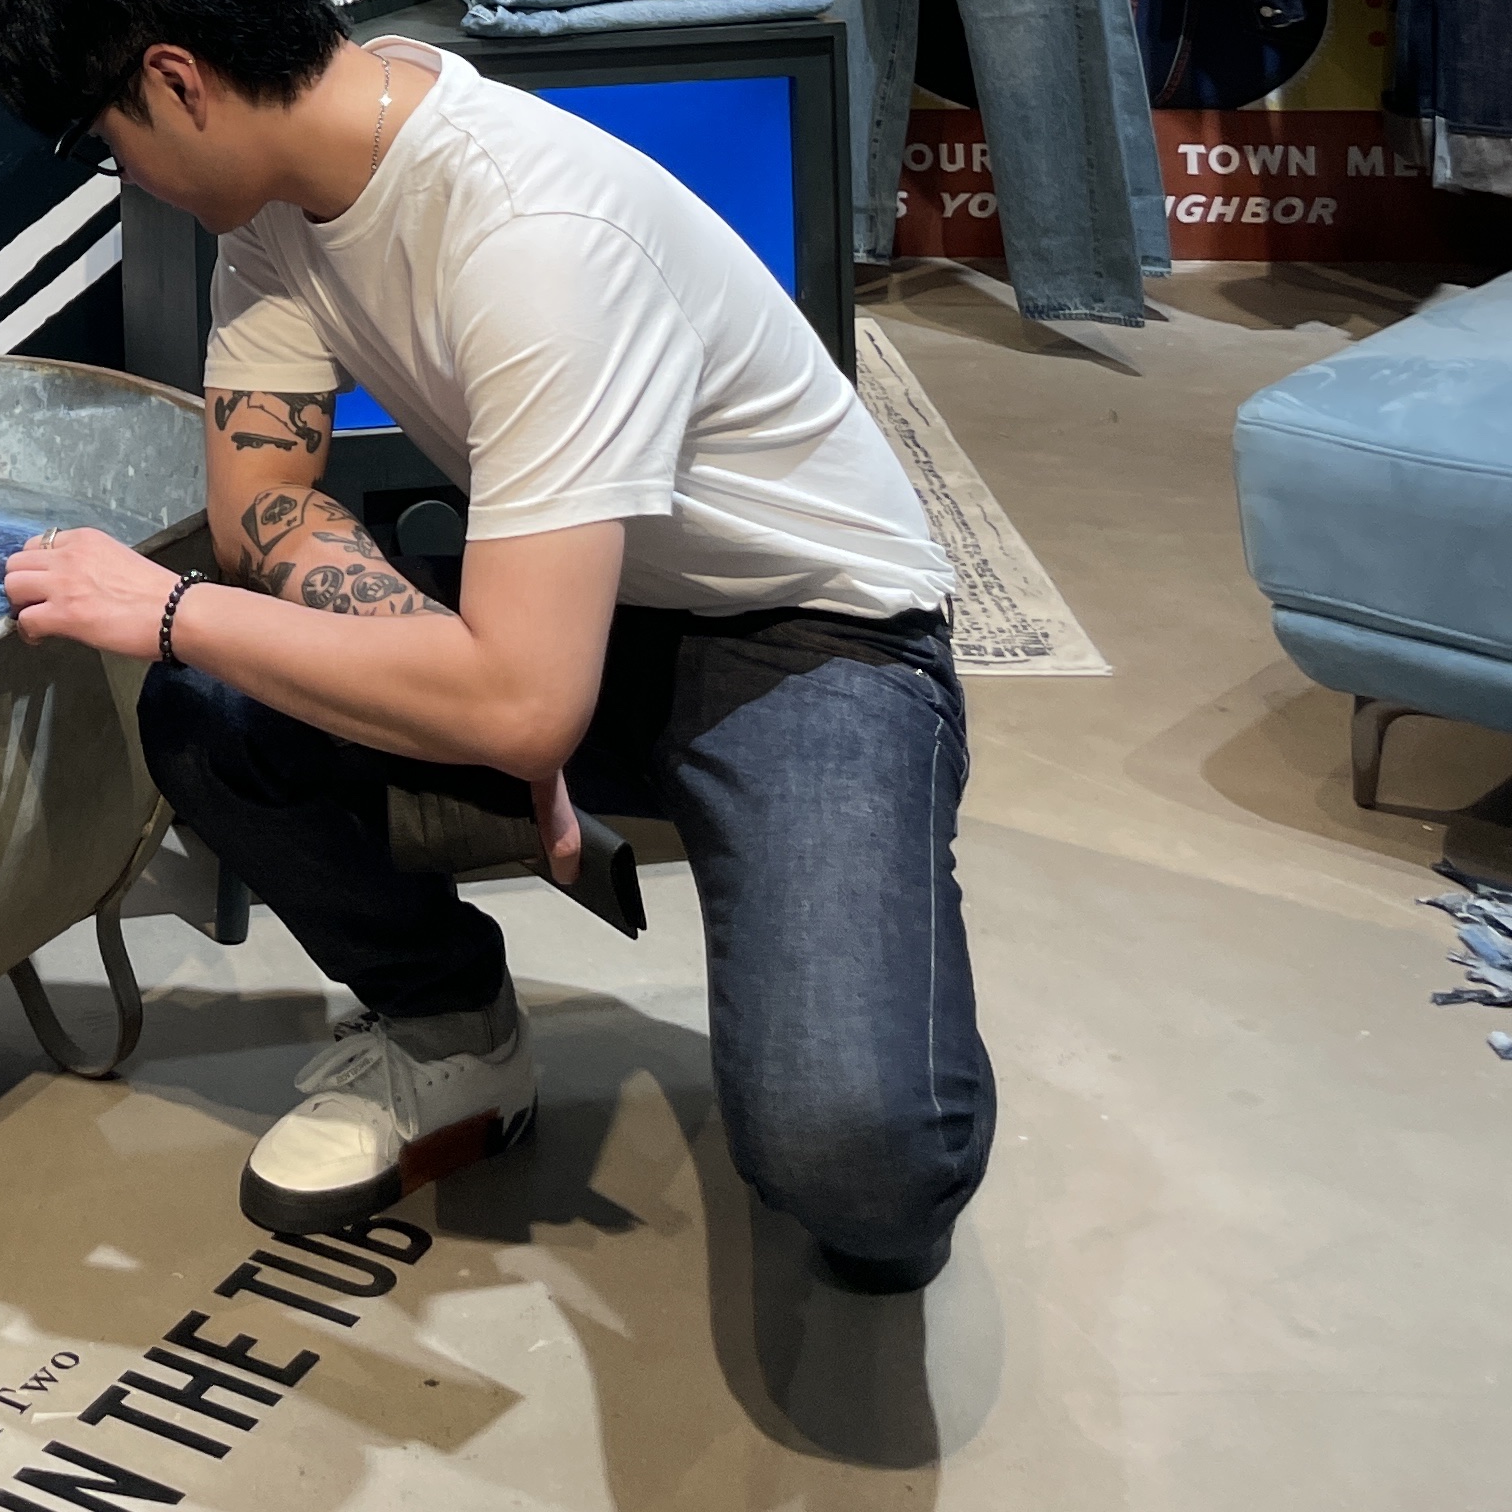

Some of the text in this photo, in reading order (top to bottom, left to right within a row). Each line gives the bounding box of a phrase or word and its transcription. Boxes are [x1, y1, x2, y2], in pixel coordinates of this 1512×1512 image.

[1178, 144, 1316, 176] TOWN
[77, 1309, 320, 1459] THE
[214, 1216, 433, 1328] TUB
